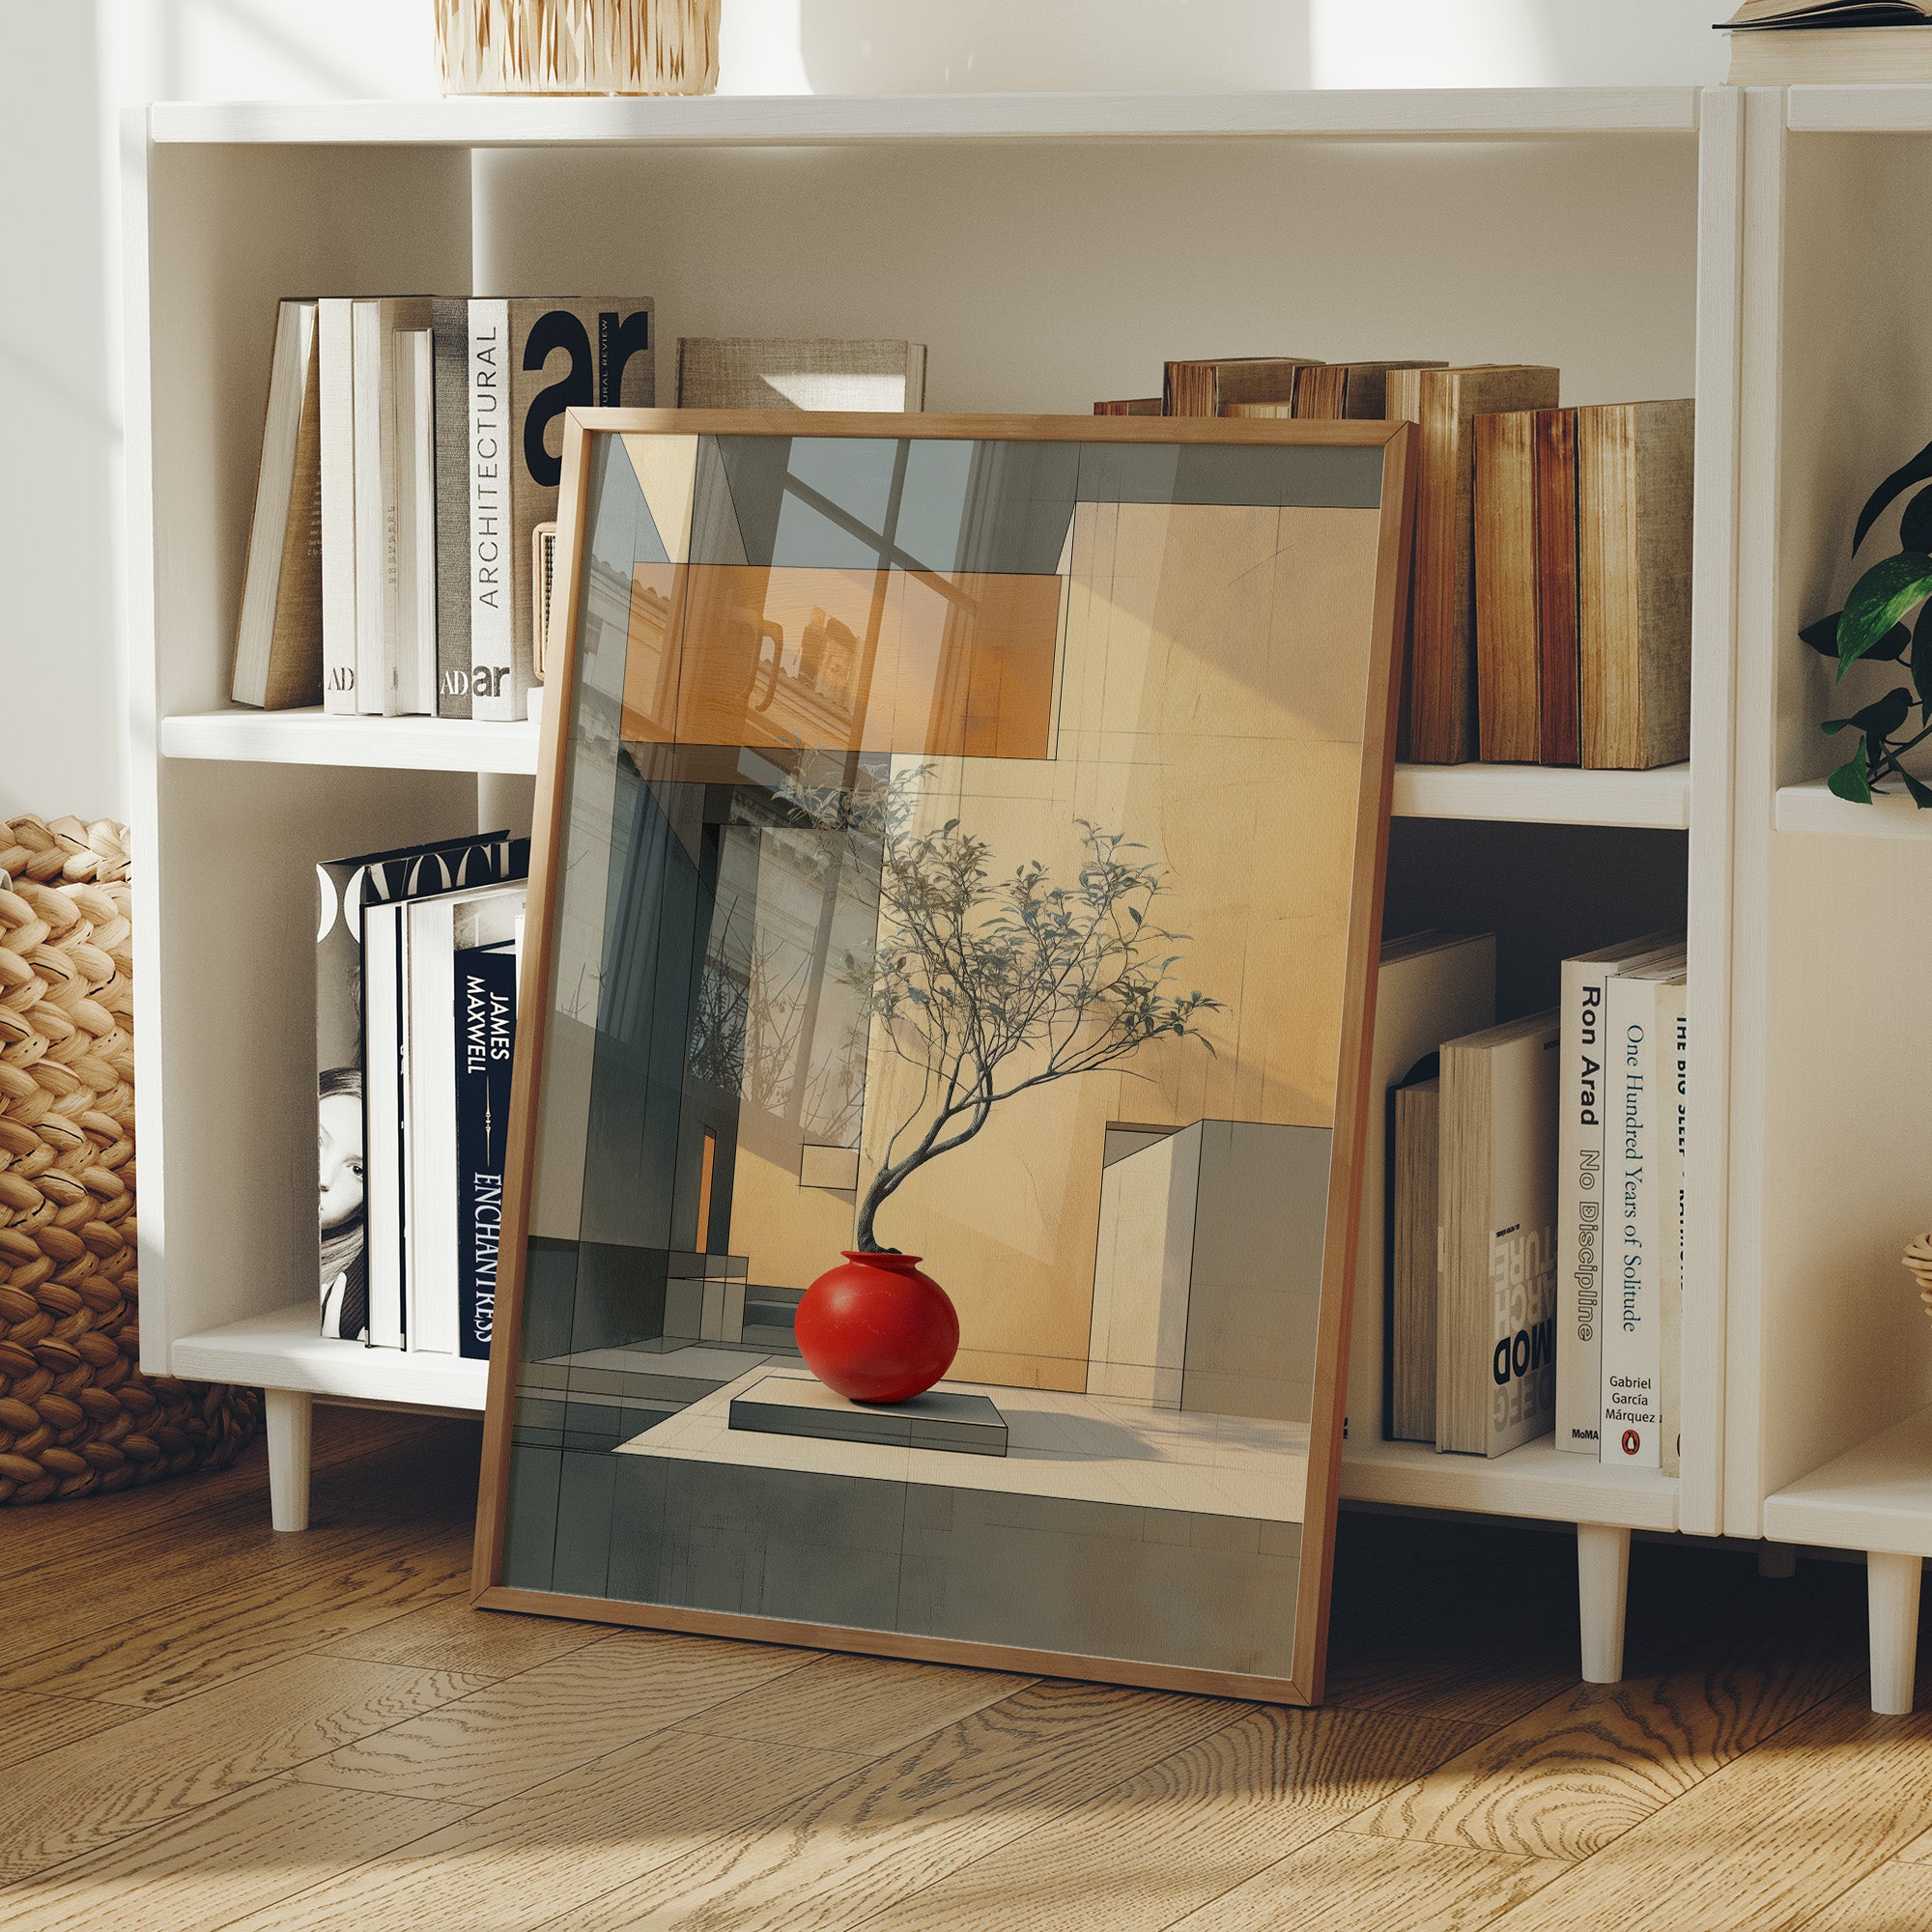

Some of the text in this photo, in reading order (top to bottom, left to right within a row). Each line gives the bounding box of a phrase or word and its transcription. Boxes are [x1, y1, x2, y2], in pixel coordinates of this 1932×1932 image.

[523, 310, 648, 487] ar
[476, 327, 498, 609] ARCHITECTURAL
[327, 667, 355, 691] AD
[440, 670, 469, 699] AD
[472, 666, 510, 697] ar
[467, 975, 486, 1074] MAXWELL
[490, 991, 510, 1061] JAMES
[1575, 986, 1601, 1341] Ron Arad No Discipline
[1623, 1024, 1644, 1332] One Hundred Years of Solitude
[1609, 1376, 1651, 1389] Gabriel
[1611, 1392, 1648, 1406] García
[1605, 1408, 1655, 1424] Márquez
[1572, 1429, 1599, 1439] MoMA
